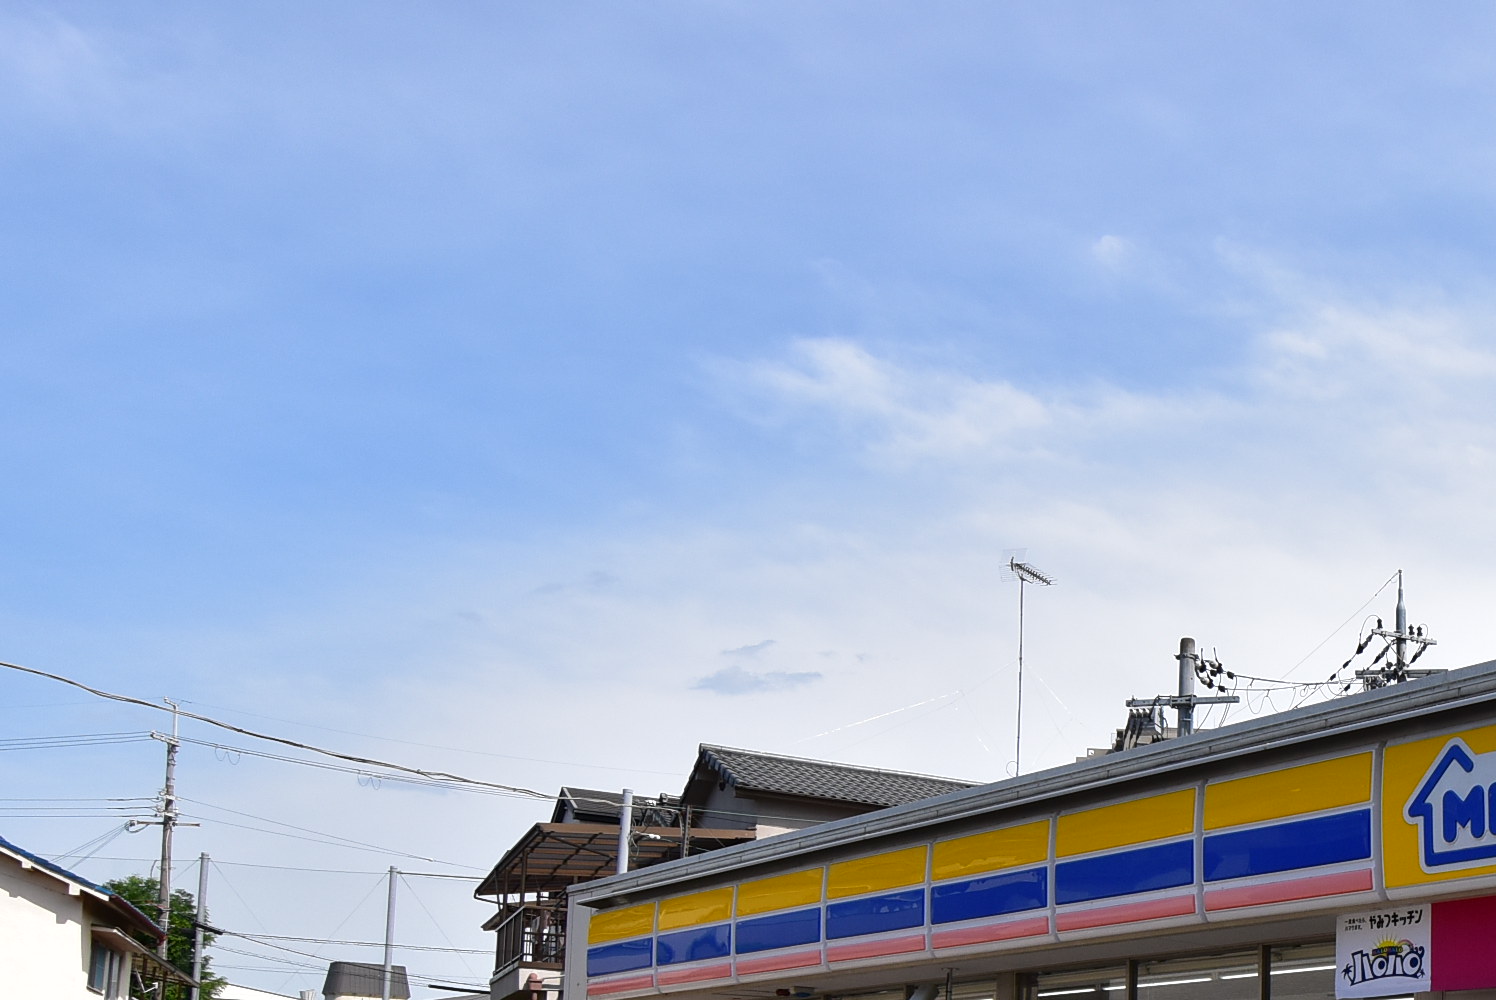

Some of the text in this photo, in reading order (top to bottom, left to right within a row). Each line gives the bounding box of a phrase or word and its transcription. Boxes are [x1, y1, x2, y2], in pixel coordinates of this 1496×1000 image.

[1369, 909, 1423, 930] やみつキッチン
